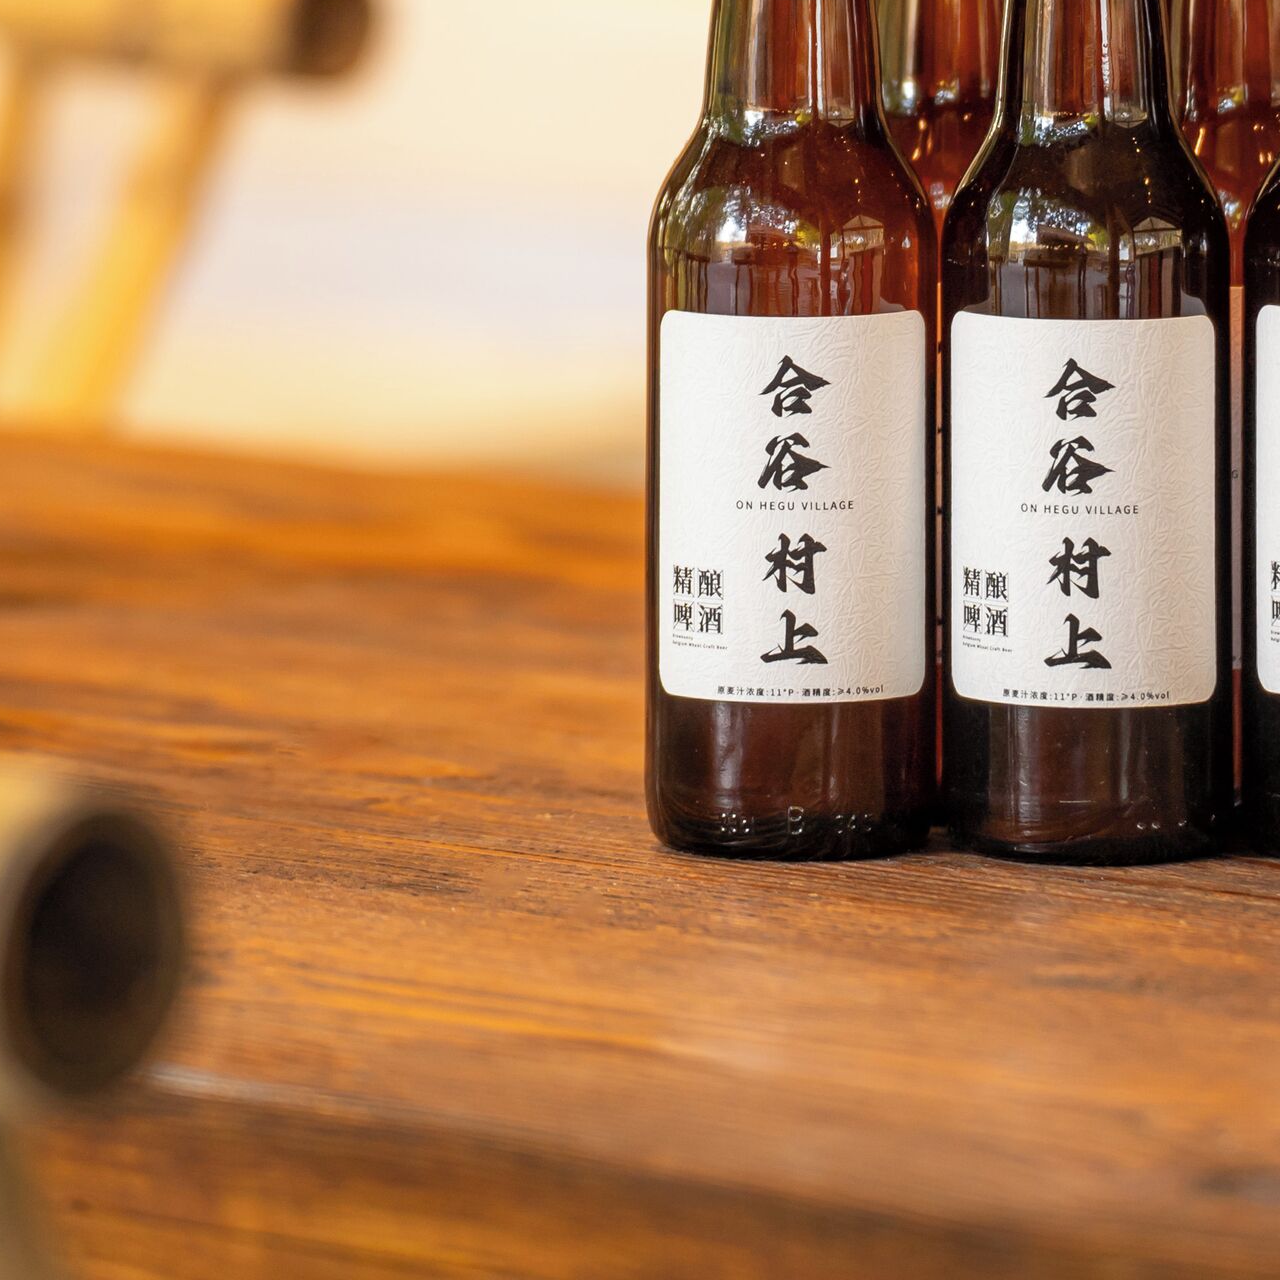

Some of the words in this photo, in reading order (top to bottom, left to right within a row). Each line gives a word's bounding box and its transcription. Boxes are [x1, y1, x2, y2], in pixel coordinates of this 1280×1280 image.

[736, 500, 753, 511] ON
[759, 501, 795, 511] HEGU
[801, 500, 854, 511] VILLAGE
[758, 354, 832, 665] 合谷村上
[1020, 503, 1037, 514] ON
[1044, 504, 1079, 515] HEGU
[1085, 504, 1139, 515] VILLAGE
[1042, 357, 1116, 670] 合谷村上
